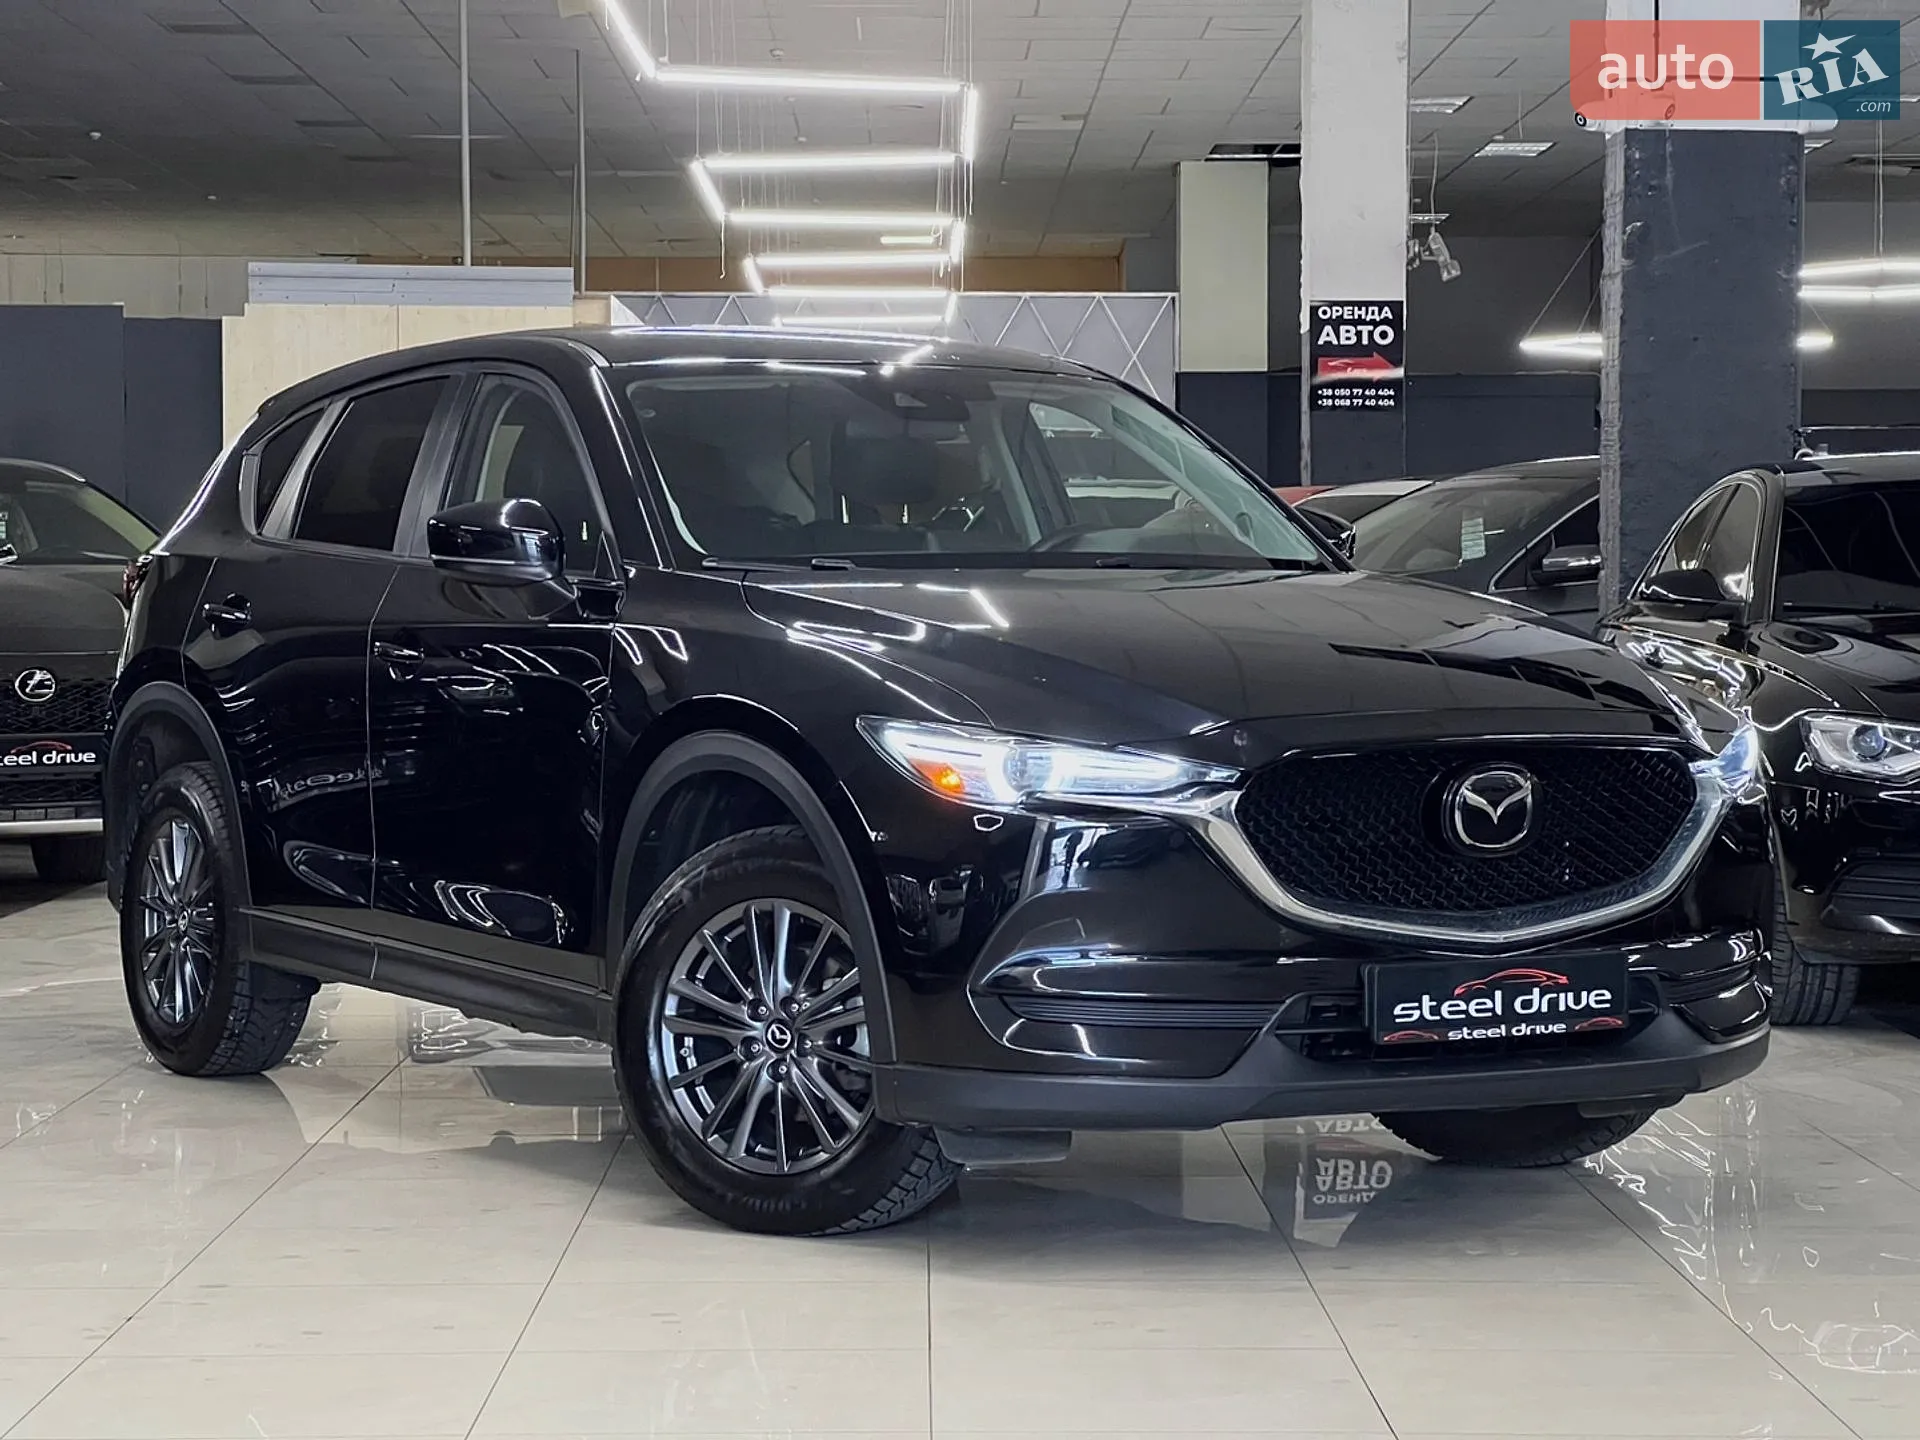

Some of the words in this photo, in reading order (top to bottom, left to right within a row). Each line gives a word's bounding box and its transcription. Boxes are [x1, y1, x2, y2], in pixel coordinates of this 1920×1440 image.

[1317, 306, 1394, 322] ОРЕНДА
[1317, 325, 1395, 345] АВТО
[1334, 388, 1351, 396] 050
[1352, 388, 1363, 396] 77
[1364, 388, 1376, 396] 40
[1377, 388, 1395, 396] 404
[1352, 398, 1363, 406] 77
[1364, 398, 1376, 406] 40
[1377, 398, 1395, 406] 404
[42, 750, 96, 764] drive
[1393, 989, 1503, 1023] steel
[1513, 987, 1612, 1015] drive
[1447, 1024, 1506, 1041] steel
[1511, 1022, 1567, 1037] drive
